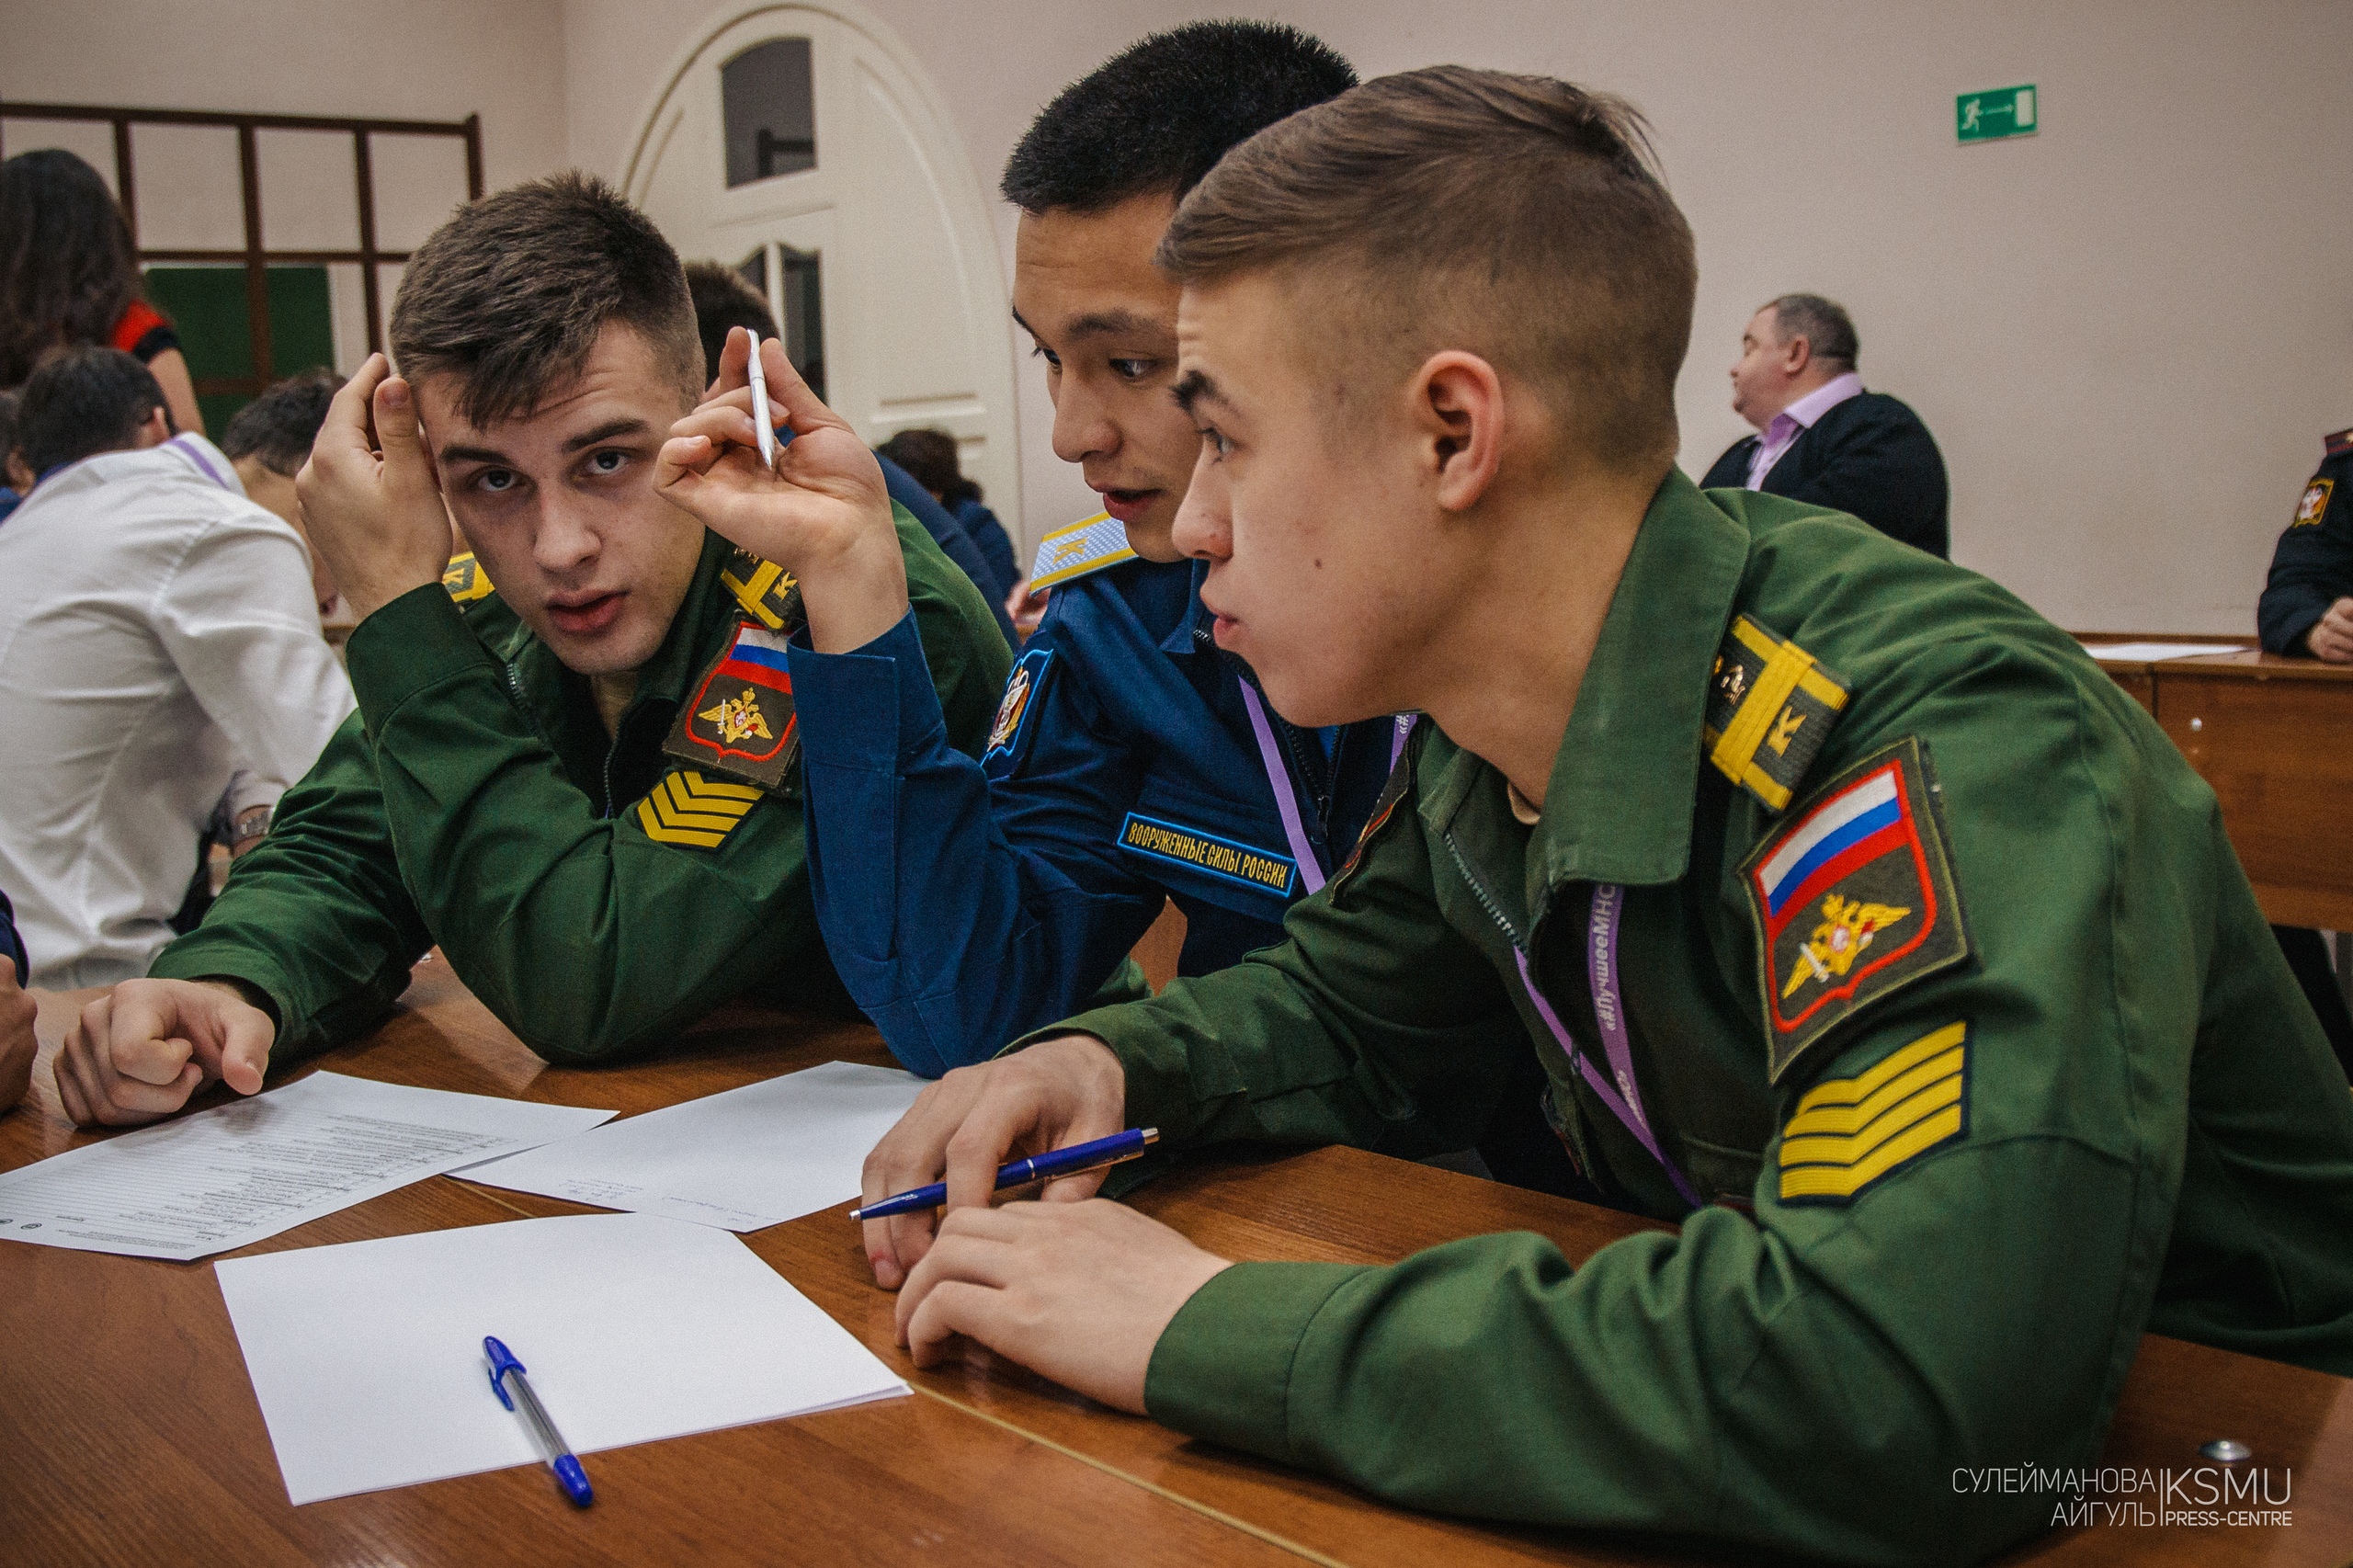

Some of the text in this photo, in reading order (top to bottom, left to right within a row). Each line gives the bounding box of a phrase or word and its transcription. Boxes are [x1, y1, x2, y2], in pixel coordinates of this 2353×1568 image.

[1128, 823, 1288, 888] ВООРУЖЕННЫЕ СИЛЫ РОССИИ
